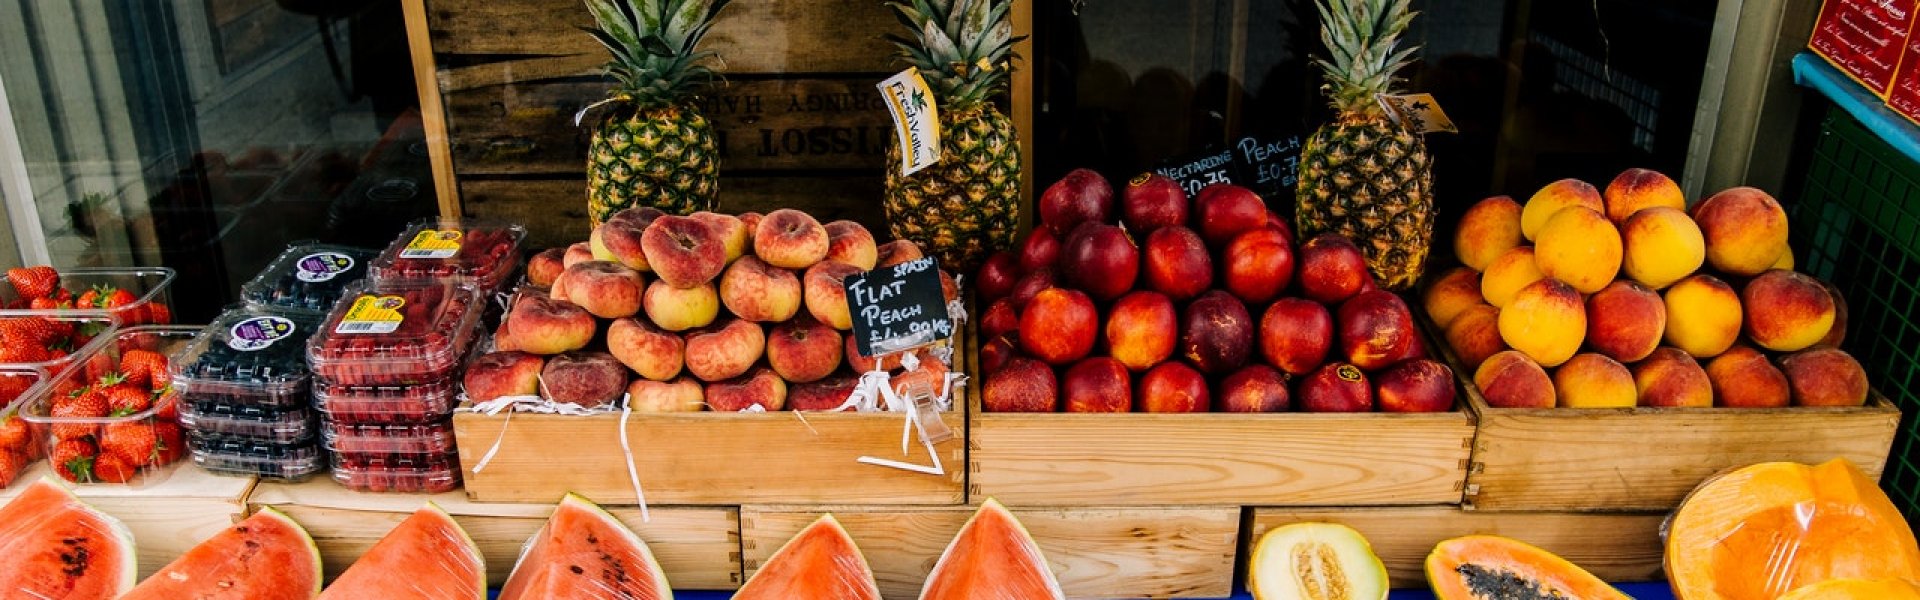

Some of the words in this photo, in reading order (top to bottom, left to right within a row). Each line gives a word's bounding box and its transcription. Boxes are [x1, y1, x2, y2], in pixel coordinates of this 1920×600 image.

[1237, 135, 1300, 164] PEACH
[1156, 149, 1233, 180] NECTARINE
[894, 257, 933, 278] SPAIN
[848, 279, 906, 306] FLAT
[861, 305, 922, 327] PEACH
